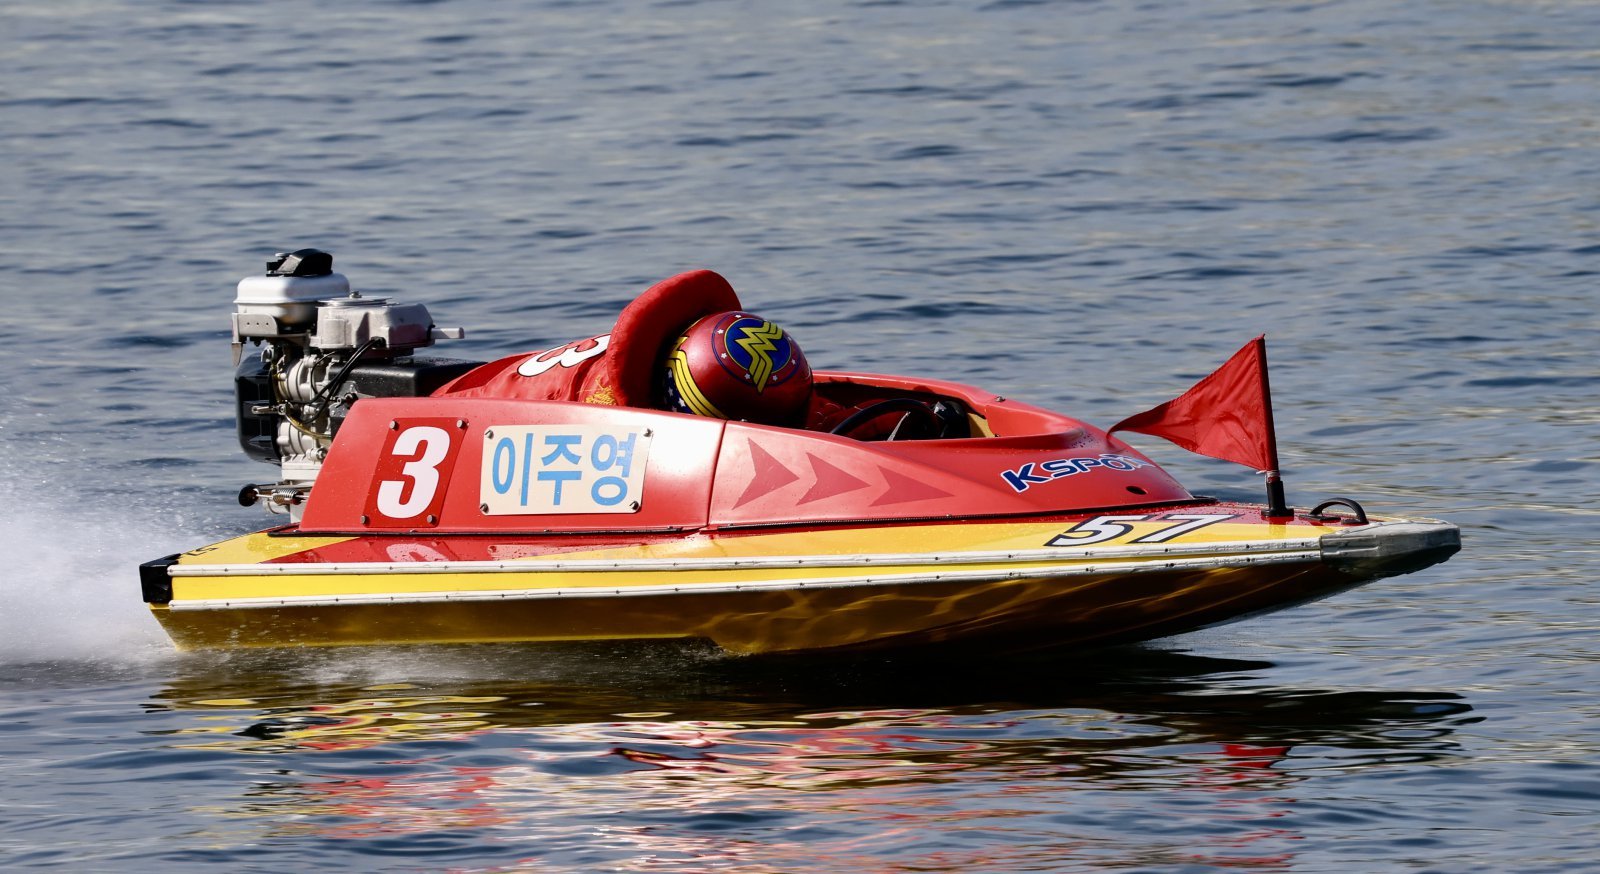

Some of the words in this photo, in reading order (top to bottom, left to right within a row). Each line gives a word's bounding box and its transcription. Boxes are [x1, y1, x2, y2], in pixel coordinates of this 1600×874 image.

[376, 426, 450, 518] 3
[492, 432, 637, 507] 이주영
[1042, 514, 1244, 547] 57
